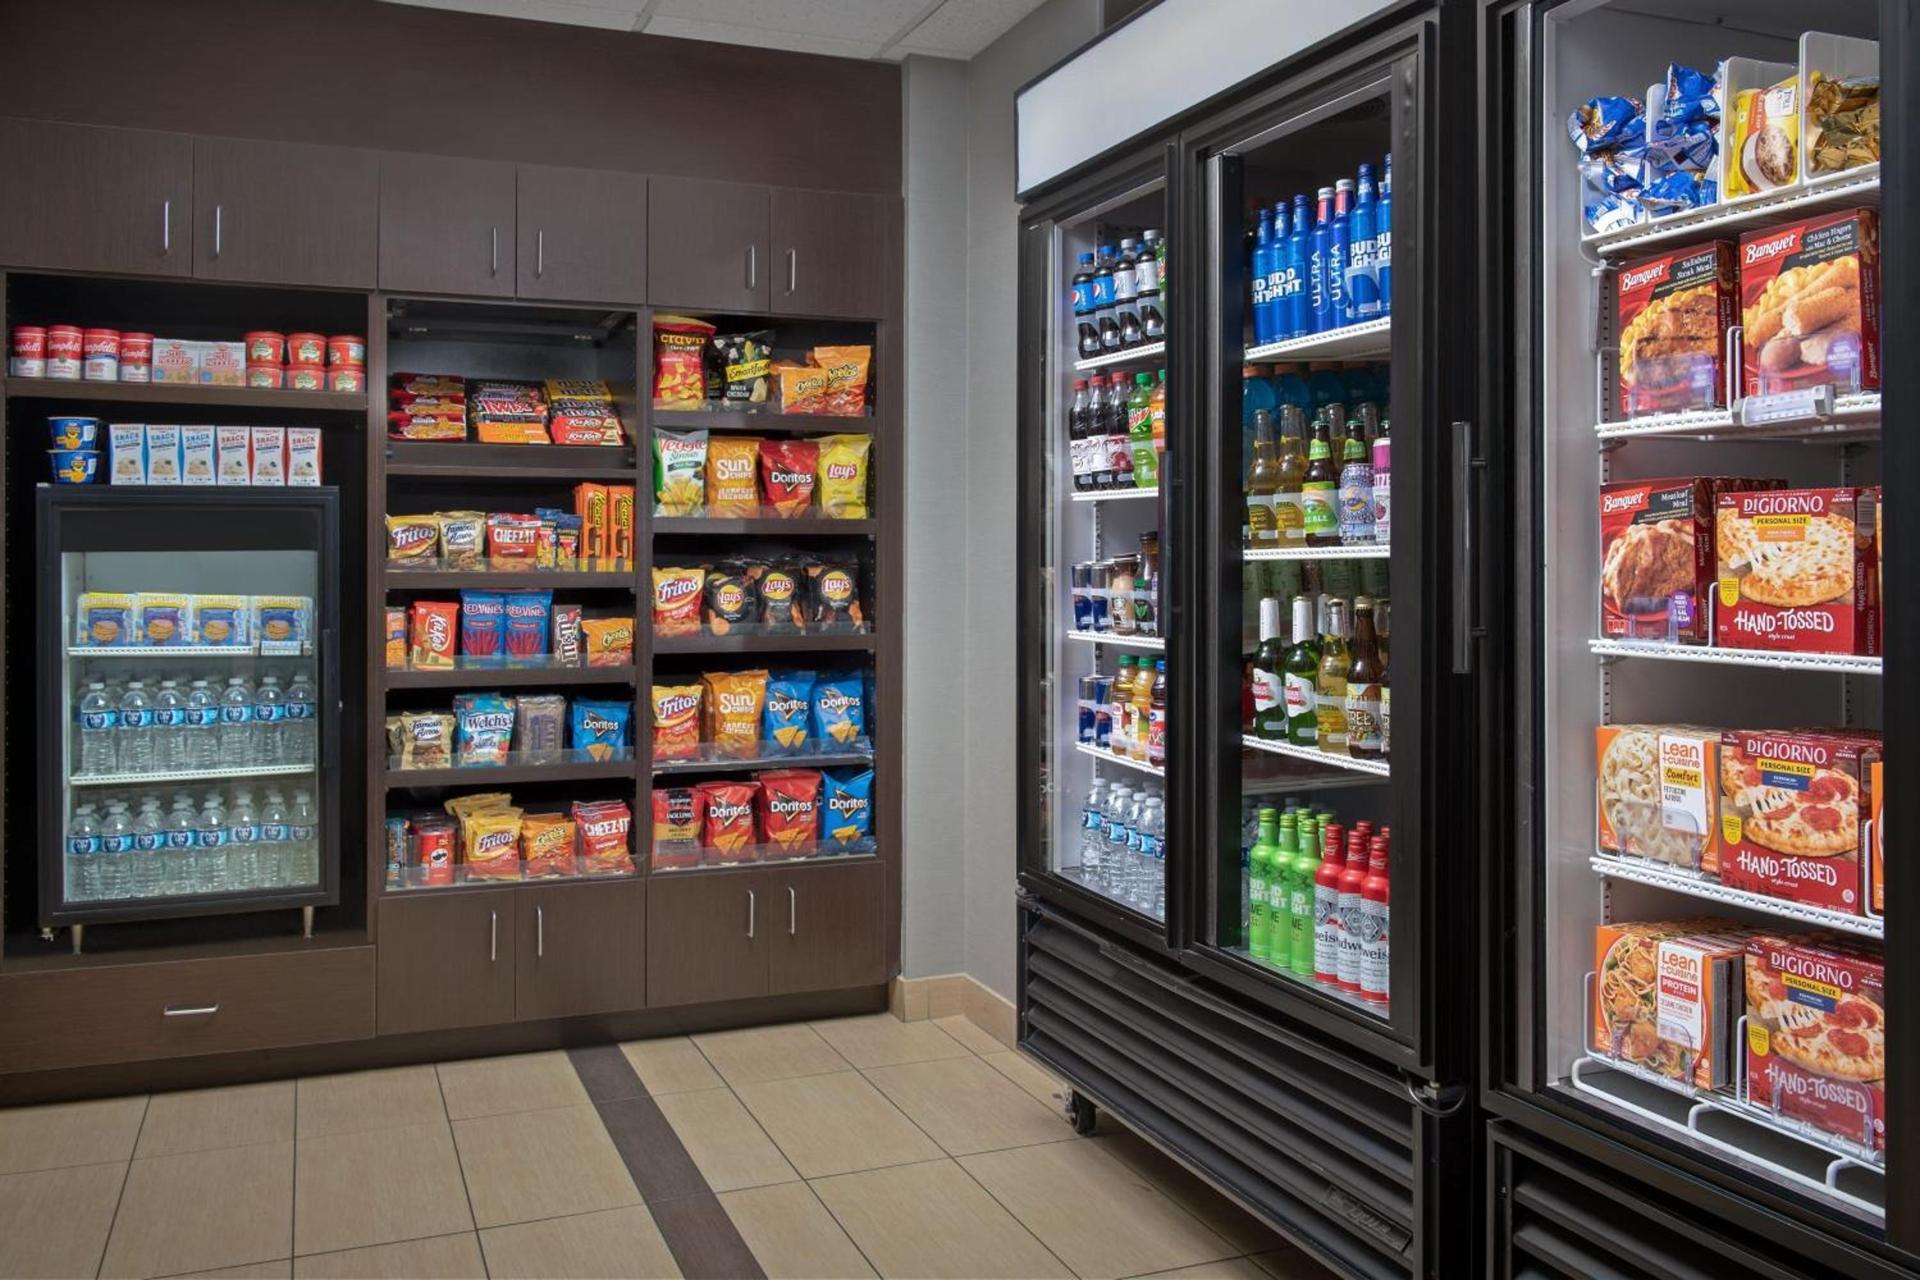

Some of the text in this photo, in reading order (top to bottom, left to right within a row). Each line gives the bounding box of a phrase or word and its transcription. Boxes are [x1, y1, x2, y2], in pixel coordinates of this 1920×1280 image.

[1746, 233, 1796, 264] Banquet
[1312, 250, 1321, 307] ULTRA
[1331, 244, 1341, 301] ULTRA
[1622, 264, 1665, 291] Banquet
[716, 459, 753, 479] Sun
[771, 472, 812, 483] Doritos
[1603, 492, 1644, 513] Banquet
[392, 524, 436, 547] Fritos
[657, 577, 698, 600] Fritos
[1734, 609, 1834, 635] HAND-TOSSED
[658, 694, 699, 719] Fritos
[719, 693, 755, 714] Sun
[769, 700, 808, 712] Doritos
[821, 697, 861, 709] Doritos
[583, 718, 619, 730] Doritos
[1663, 742, 1699, 759] Lean
[1796, 766, 1811, 774] SIZE
[709, 804, 751, 818] Doritos
[771, 801, 812, 812] Doritos
[830, 798, 868, 809] Doritos
[479, 832, 514, 851] Fritos
[1737, 851, 1837, 887] HAND-TOSSED
[1662, 951, 1697, 973] Lean
[1663, 977, 1697, 994] PROTEIN
[1820, 986, 1836, 997] SIZE
[1765, 1065, 1868, 1114] HAND-TOSSED
